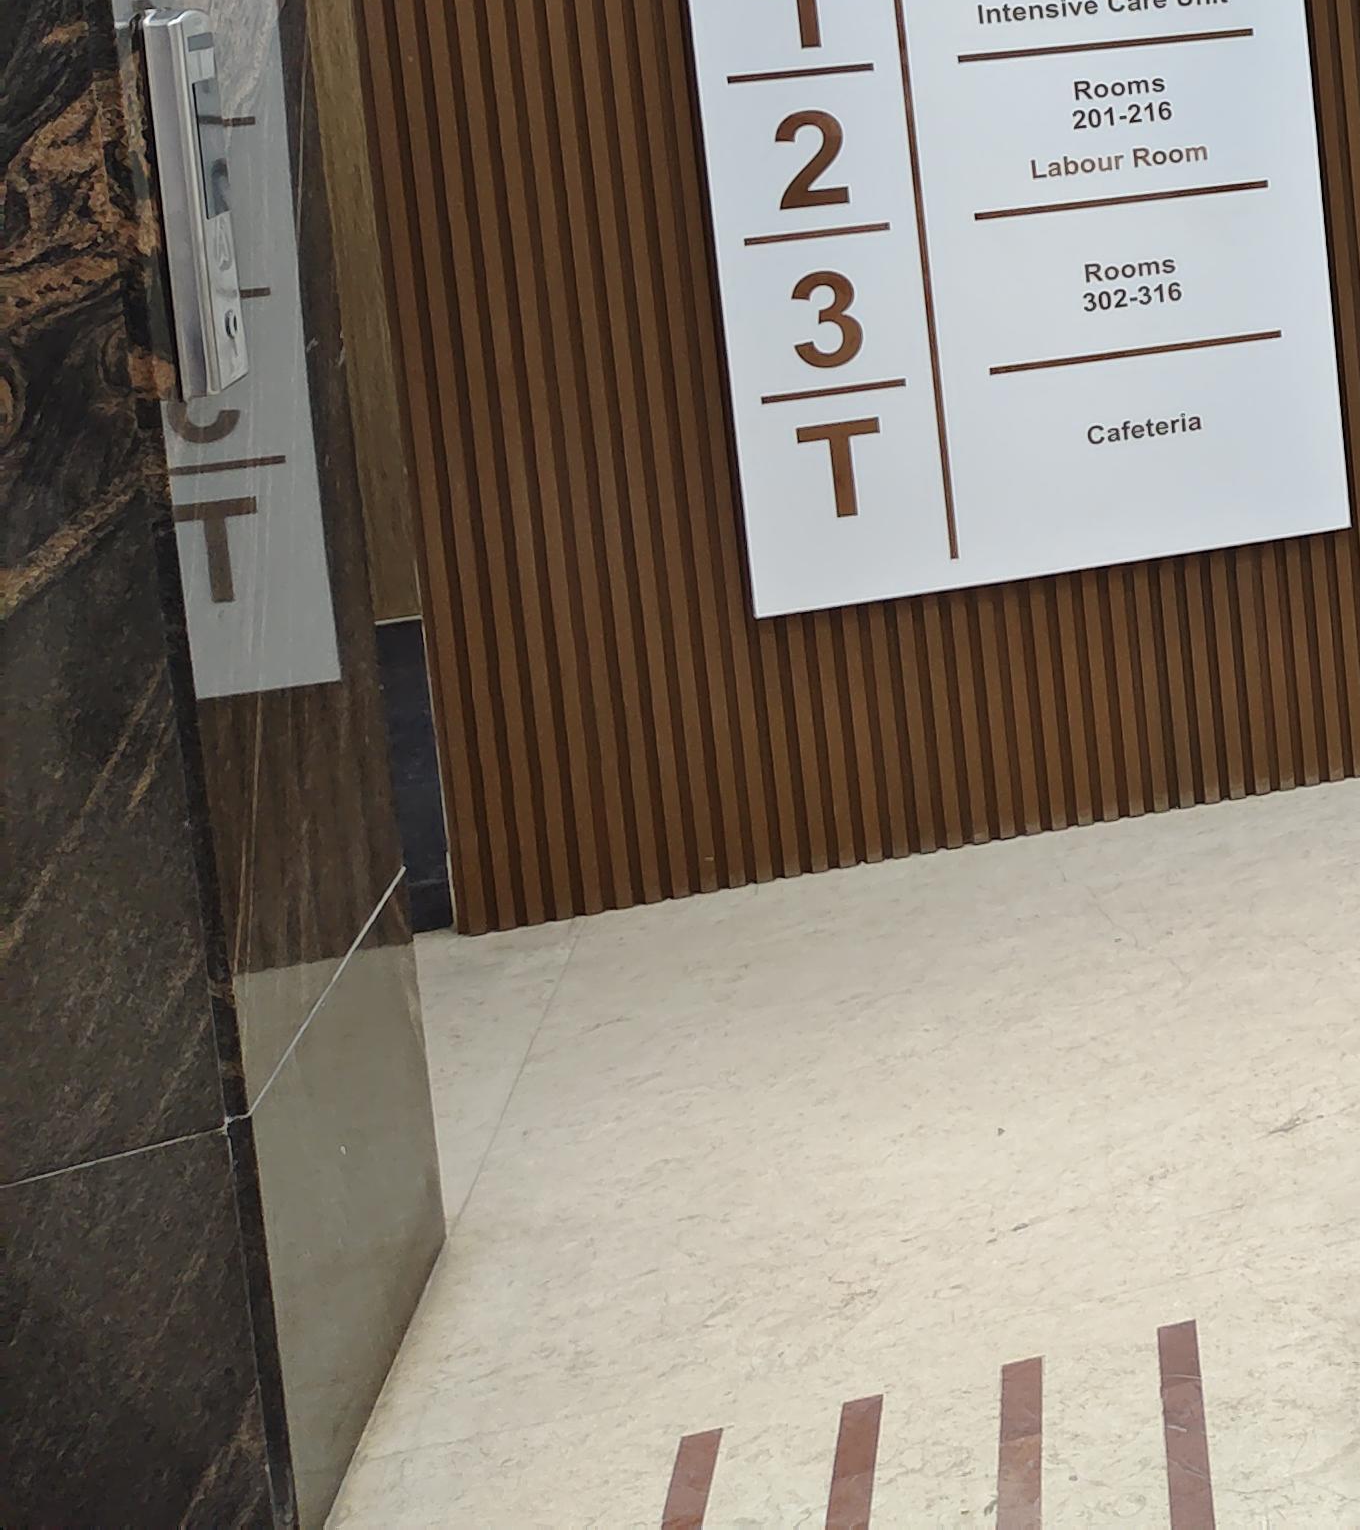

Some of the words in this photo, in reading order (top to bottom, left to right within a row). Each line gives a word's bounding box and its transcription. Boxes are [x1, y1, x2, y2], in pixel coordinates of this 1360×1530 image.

[1074, 78, 1165, 101] Rooms
[1072, 101, 1172, 130] 201-216
[775, 110, 850, 211] 2
[1030, 155, 1124, 180] Labour
[1132, 146, 1208, 168] Room
[1084, 259, 1176, 283] Rooms
[1083, 282, 1182, 312] 302-316
[791, 270, 863, 369] 3
[1087, 413, 1202, 445] Cafeteria
[795, 416, 880, 518] T
